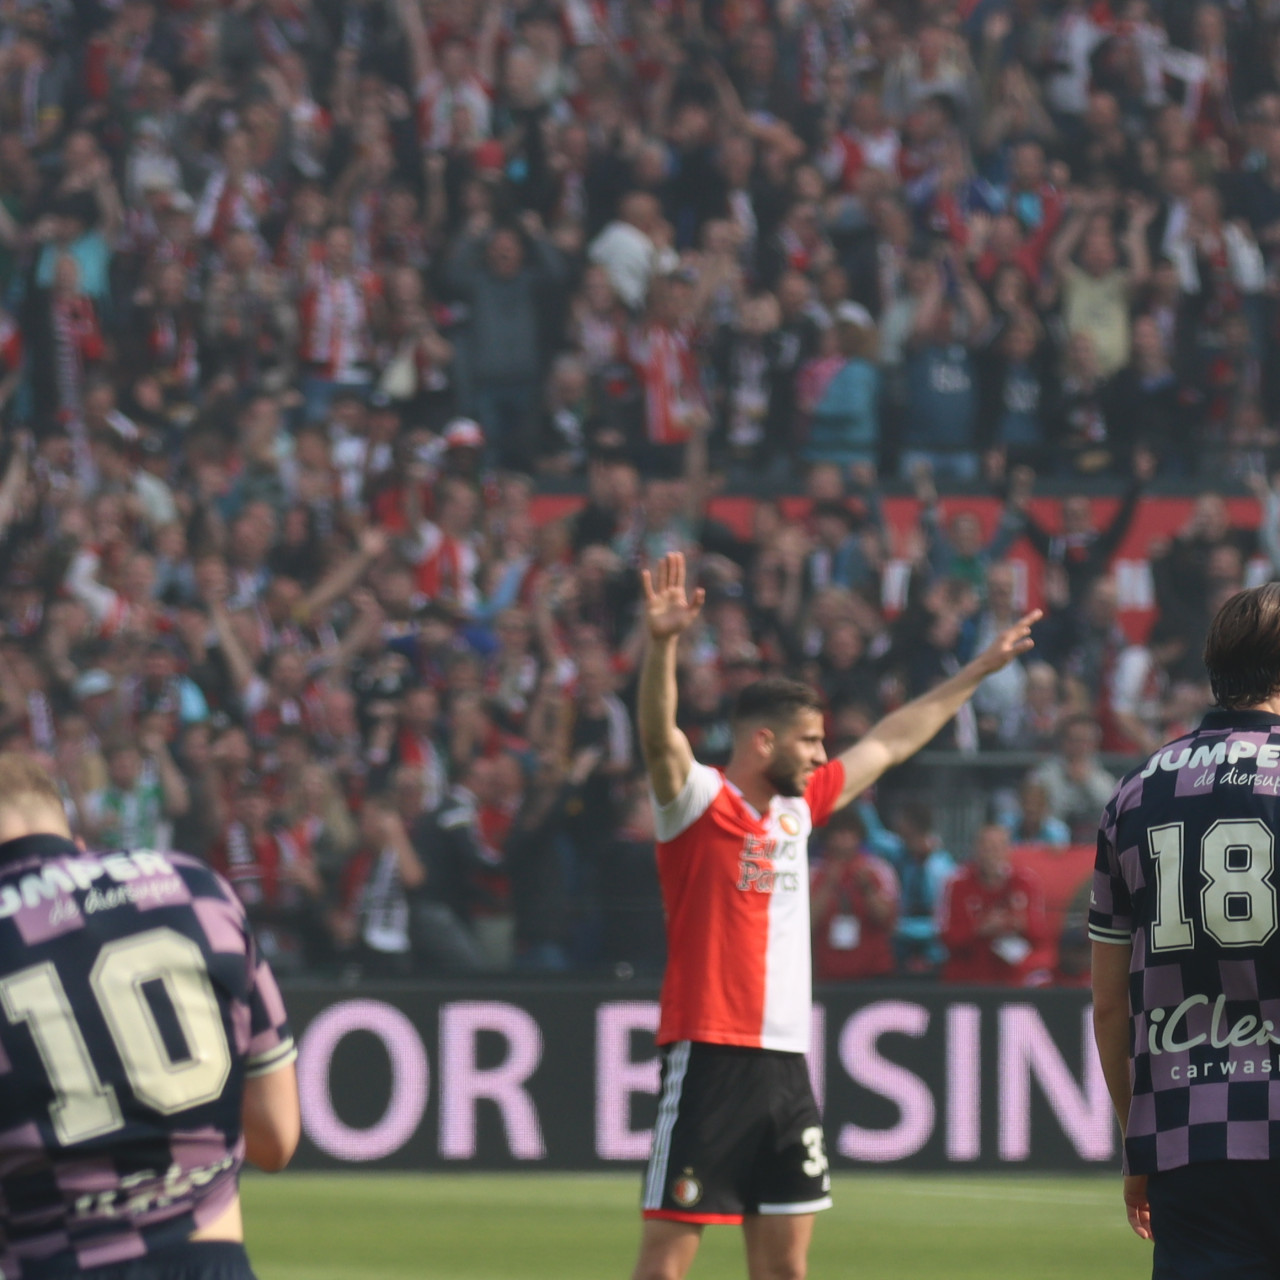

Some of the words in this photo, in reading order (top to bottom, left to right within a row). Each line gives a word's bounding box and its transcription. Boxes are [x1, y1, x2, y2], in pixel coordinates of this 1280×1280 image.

[1194, 769, 1215, 788] de
[1147, 817, 1278, 953] 18
[1, 926, 232, 1147] 10
